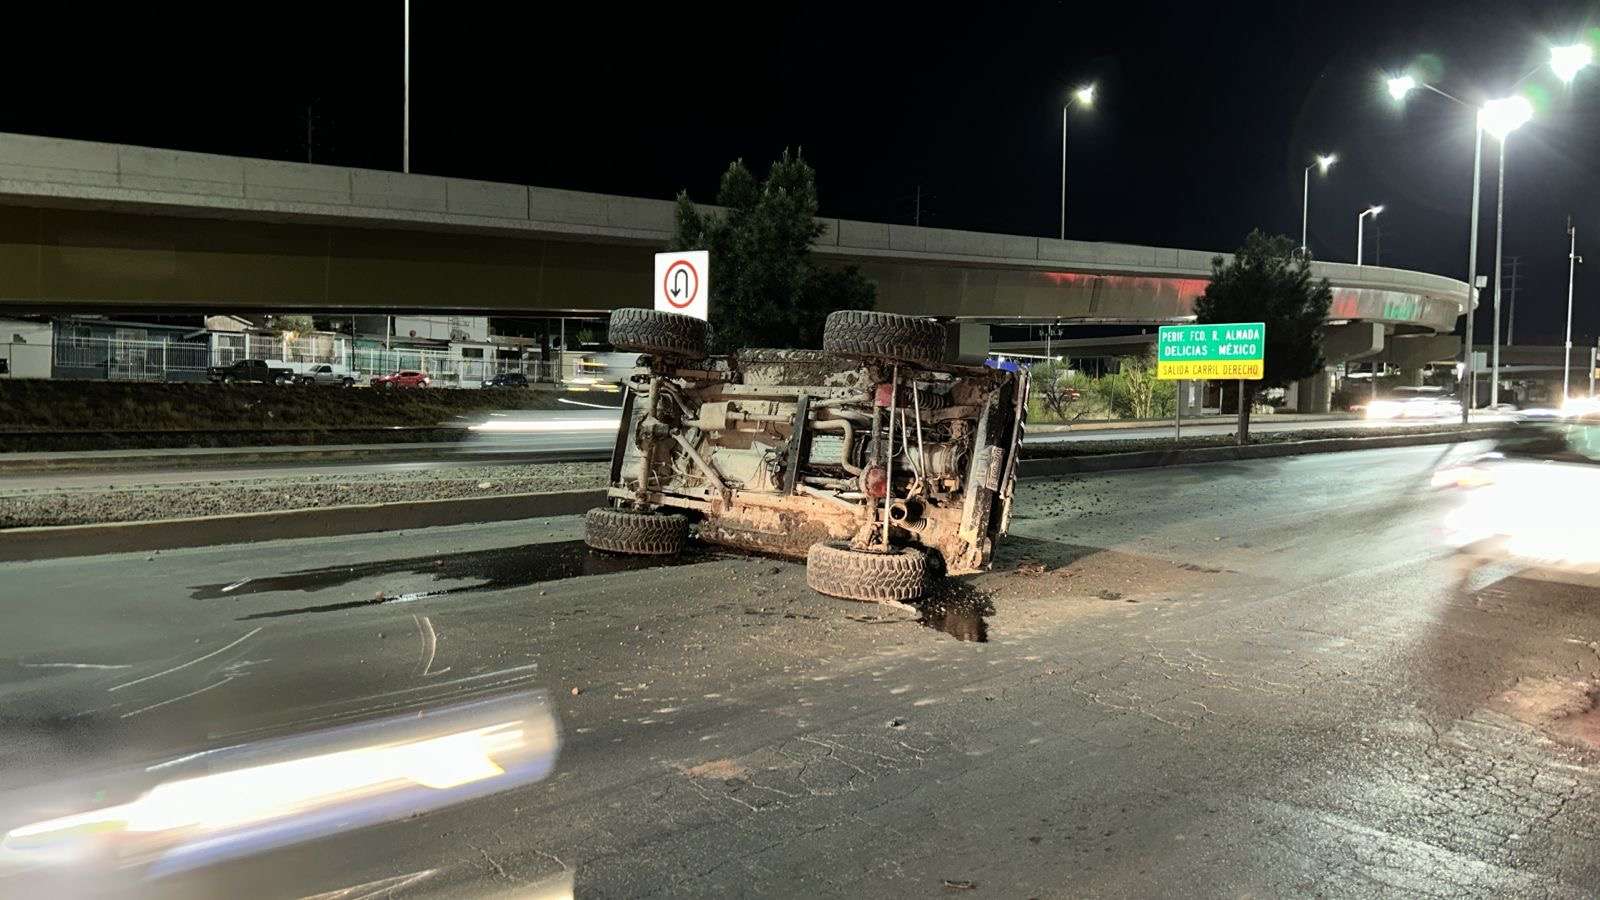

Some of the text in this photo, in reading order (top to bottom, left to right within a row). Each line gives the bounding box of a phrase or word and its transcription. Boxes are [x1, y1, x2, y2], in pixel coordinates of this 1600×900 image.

[1225, 329, 1260, 340] ALMADA
[1165, 345, 1208, 356] DELICIAS
[1218, 343, 1256, 356] MÉXICO
[1163, 364, 1259, 375] SALIDA CARRIL DERECHO
